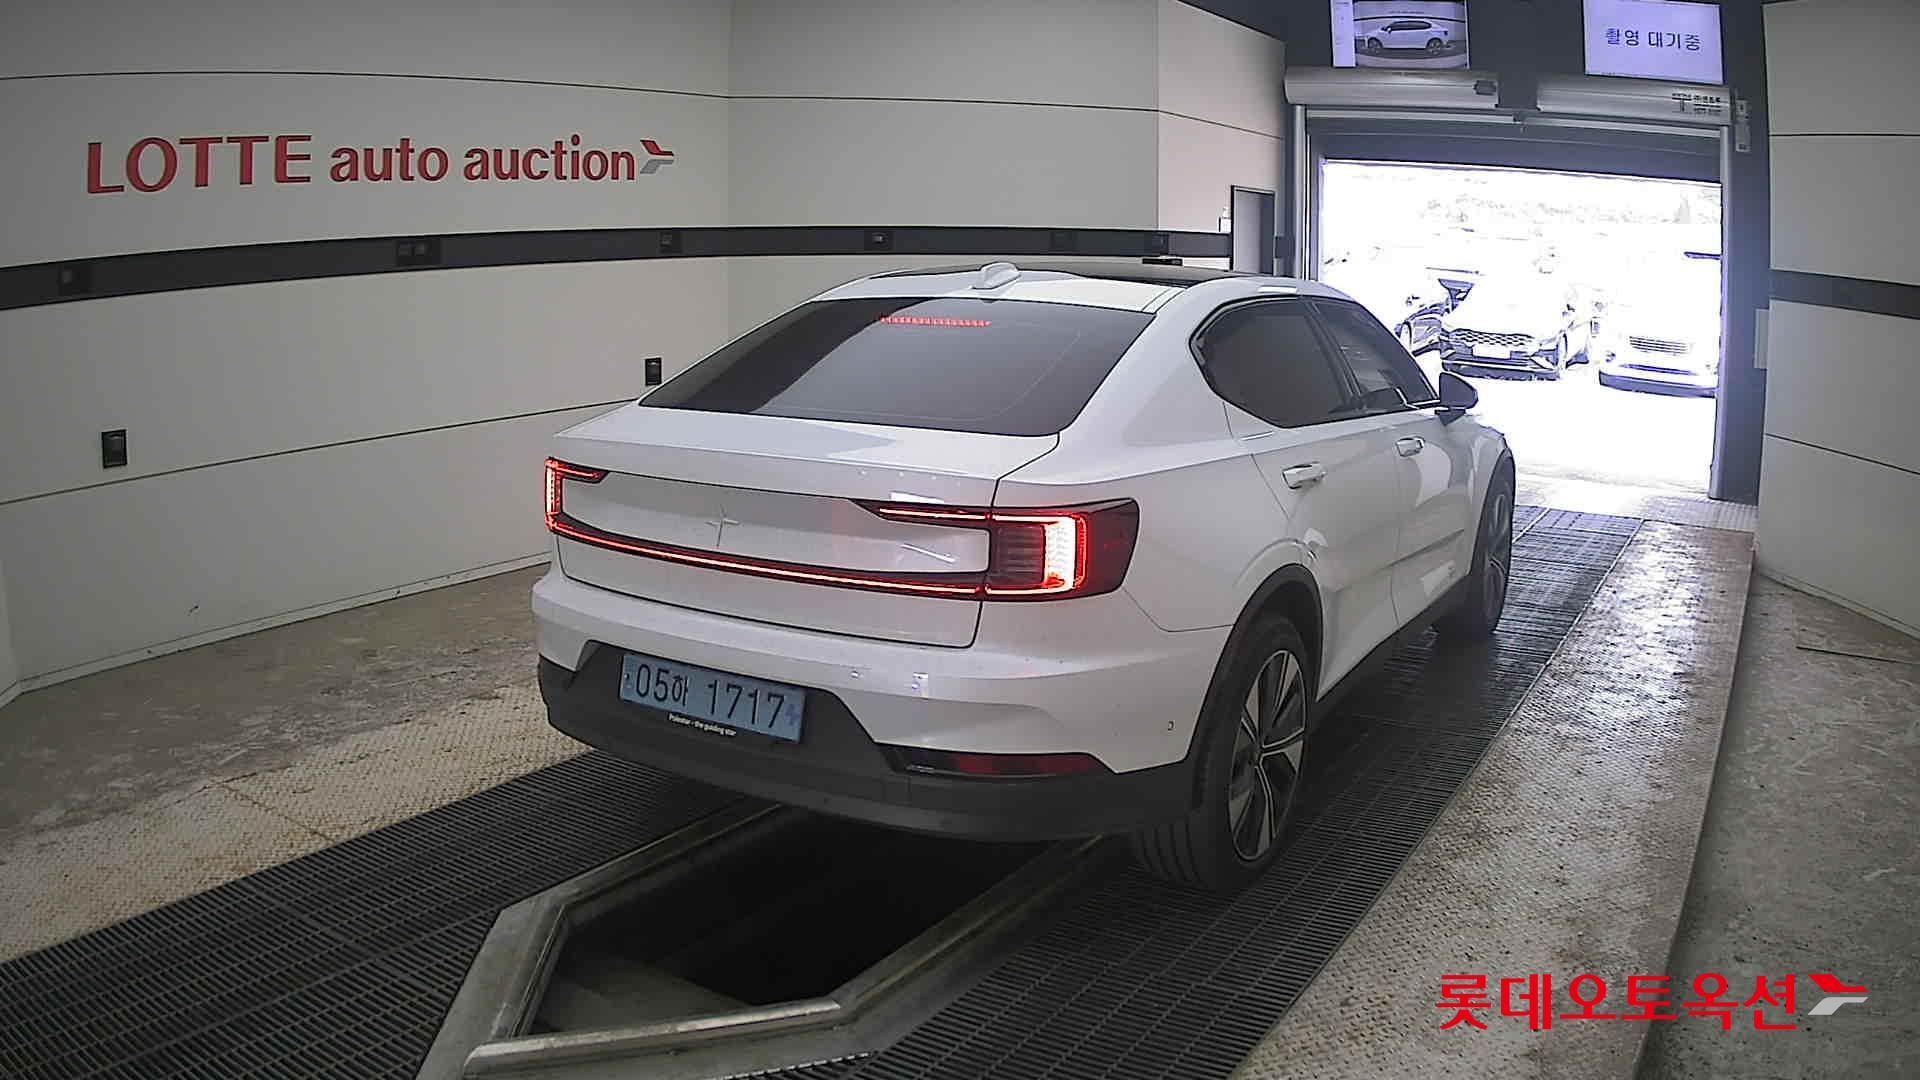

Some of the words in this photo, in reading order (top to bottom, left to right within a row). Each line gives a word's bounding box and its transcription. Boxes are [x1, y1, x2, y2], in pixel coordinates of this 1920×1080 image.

[1648, 31, 1702, 51] 대기중
[86, 134, 312, 195] LOTTE
[329, 136, 449, 183] auto
[463, 133, 636, 181] auction
[635, 663, 689, 707] 05하
[707, 679, 786, 729] 1717
